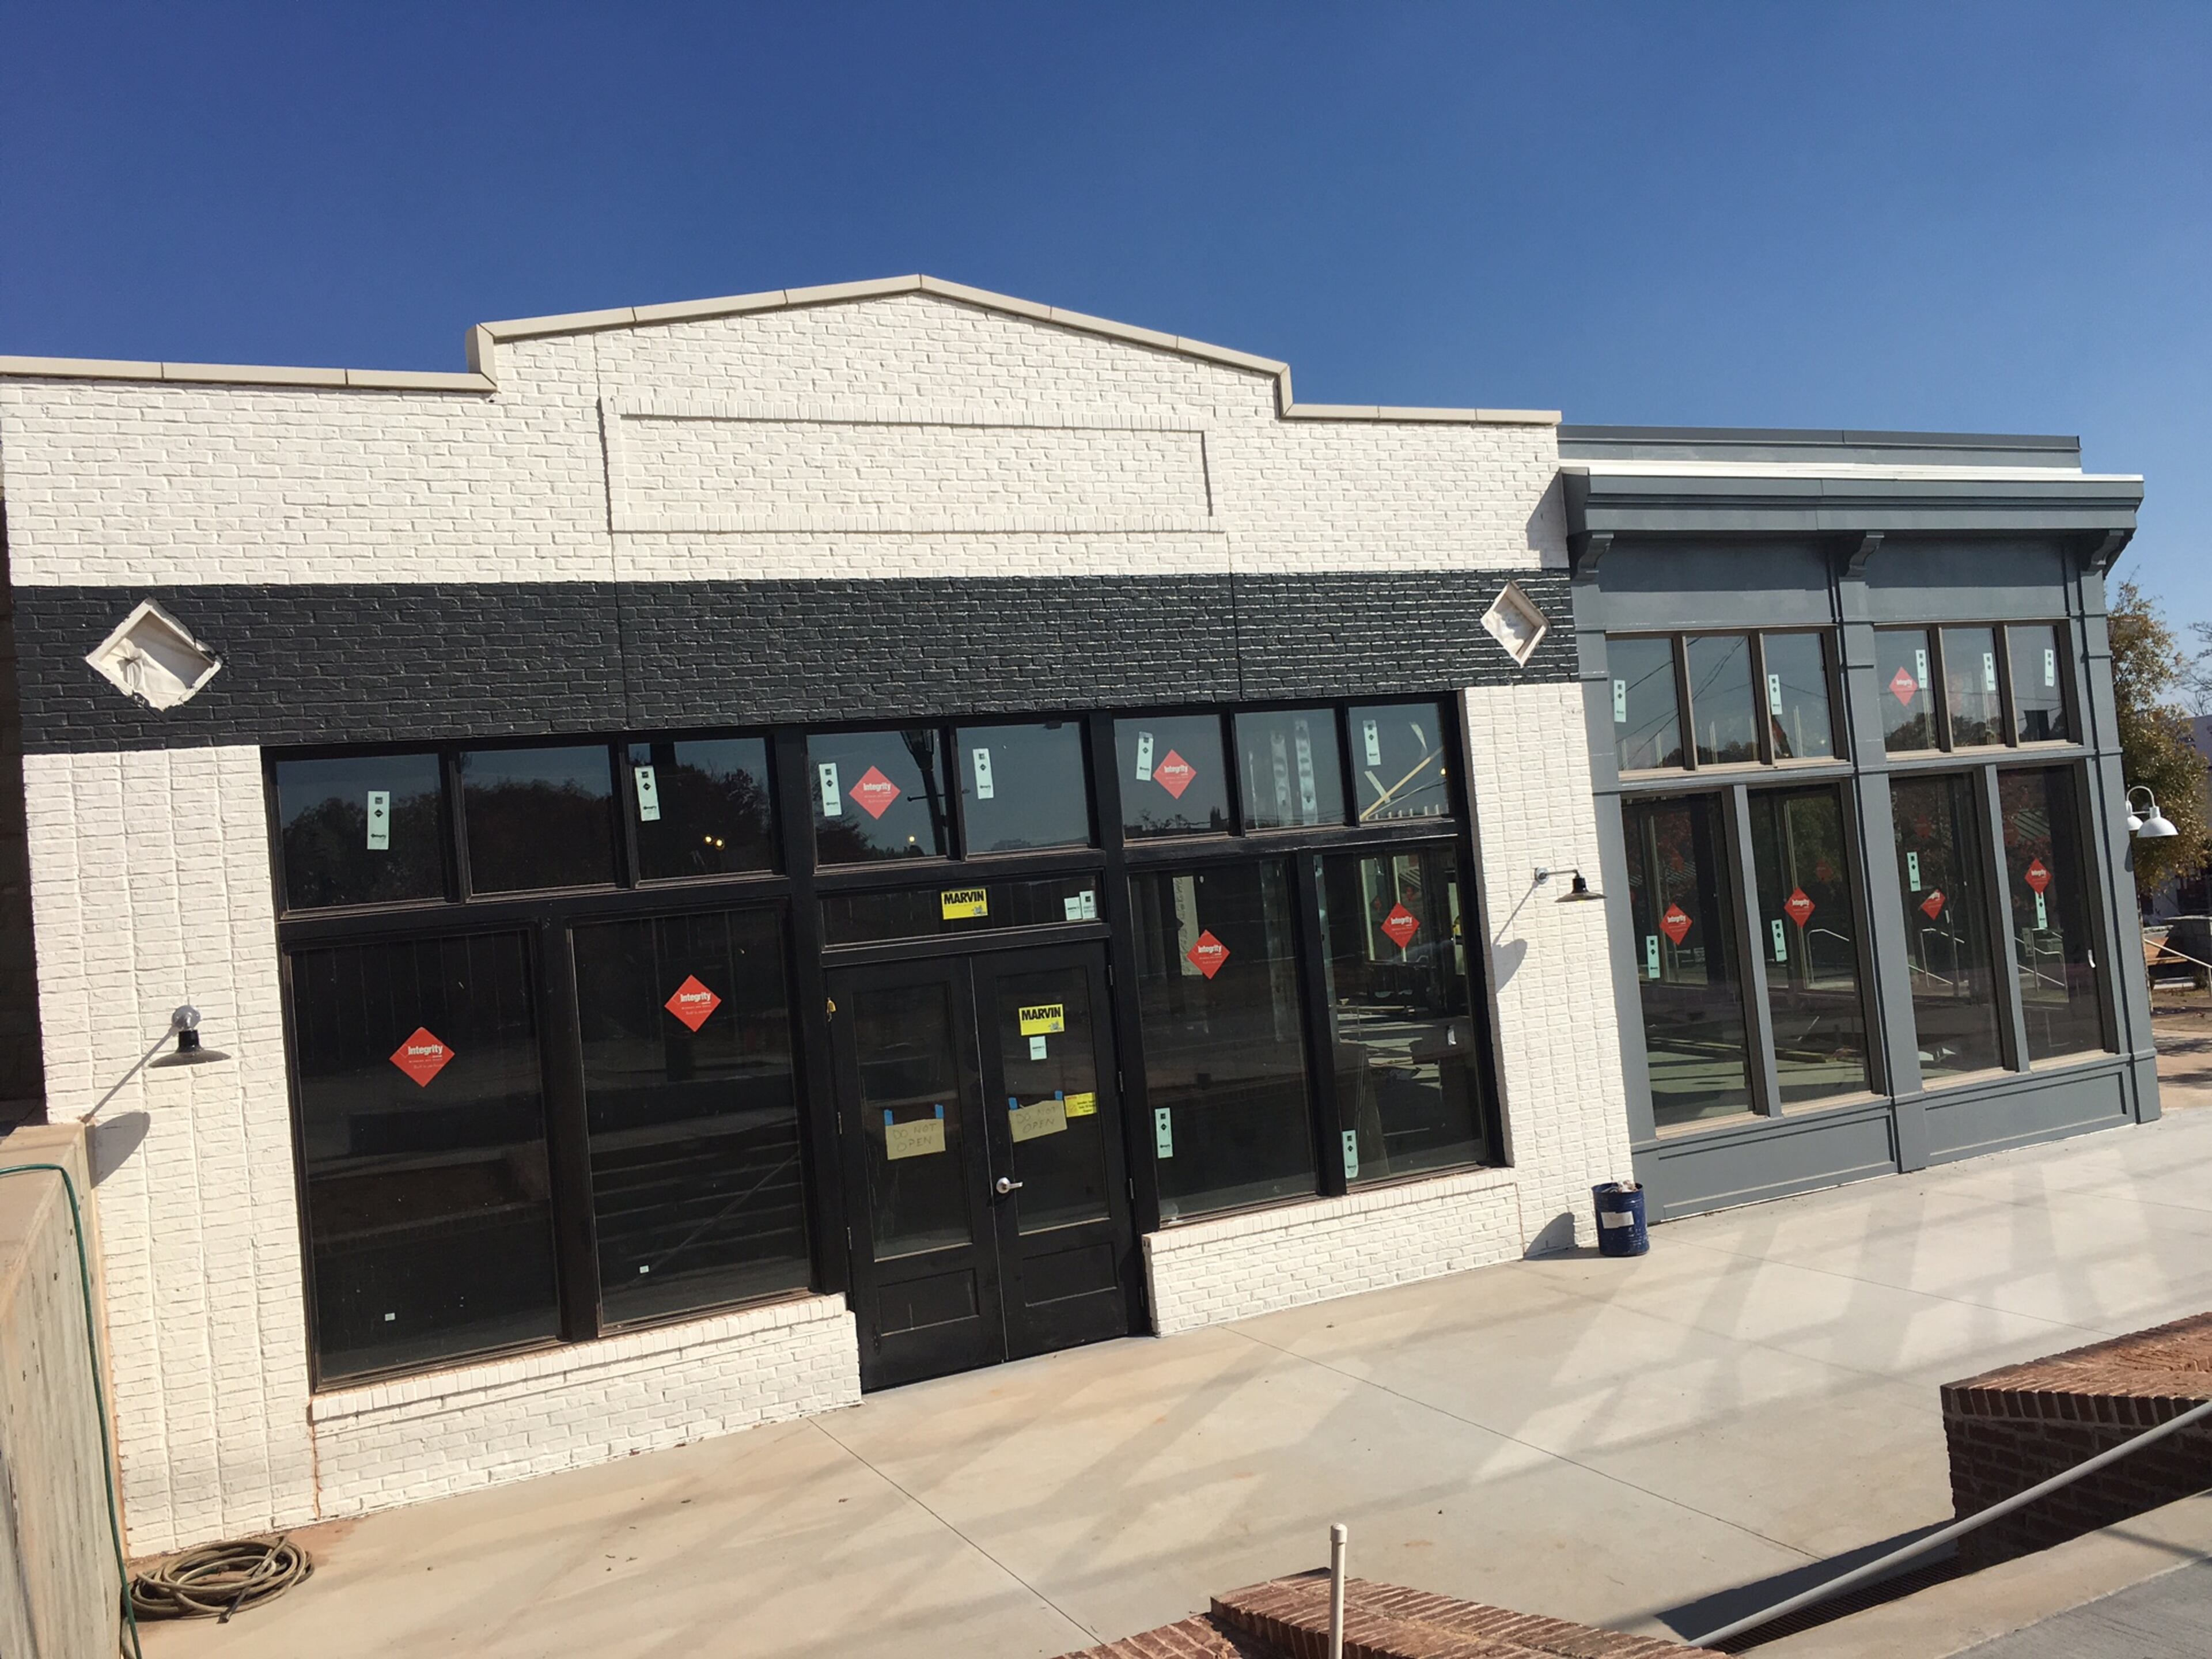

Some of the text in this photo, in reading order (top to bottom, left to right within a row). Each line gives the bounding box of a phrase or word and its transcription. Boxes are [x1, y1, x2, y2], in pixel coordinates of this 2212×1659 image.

[1164, 764, 1188, 775] Integrity
[863, 782, 891, 793] Integrity
[944, 891, 984, 904] MARVIN
[1391, 916, 1412, 925] Integrity
[1667, 915, 1685, 923] Integrity
[1198, 944, 1222, 954] Integrity
[680, 992, 711, 1003] Integrity
[1021, 1007, 1061, 1021] MARVIN
[408, 1044, 443, 1056] Integrity
[1017, 1107, 1056, 1124] DO NOT
[893, 1123, 937, 1139] DO NOT
[1022, 1118, 1055, 1134] OPEN
[897, 1135, 932, 1153] OPEN
